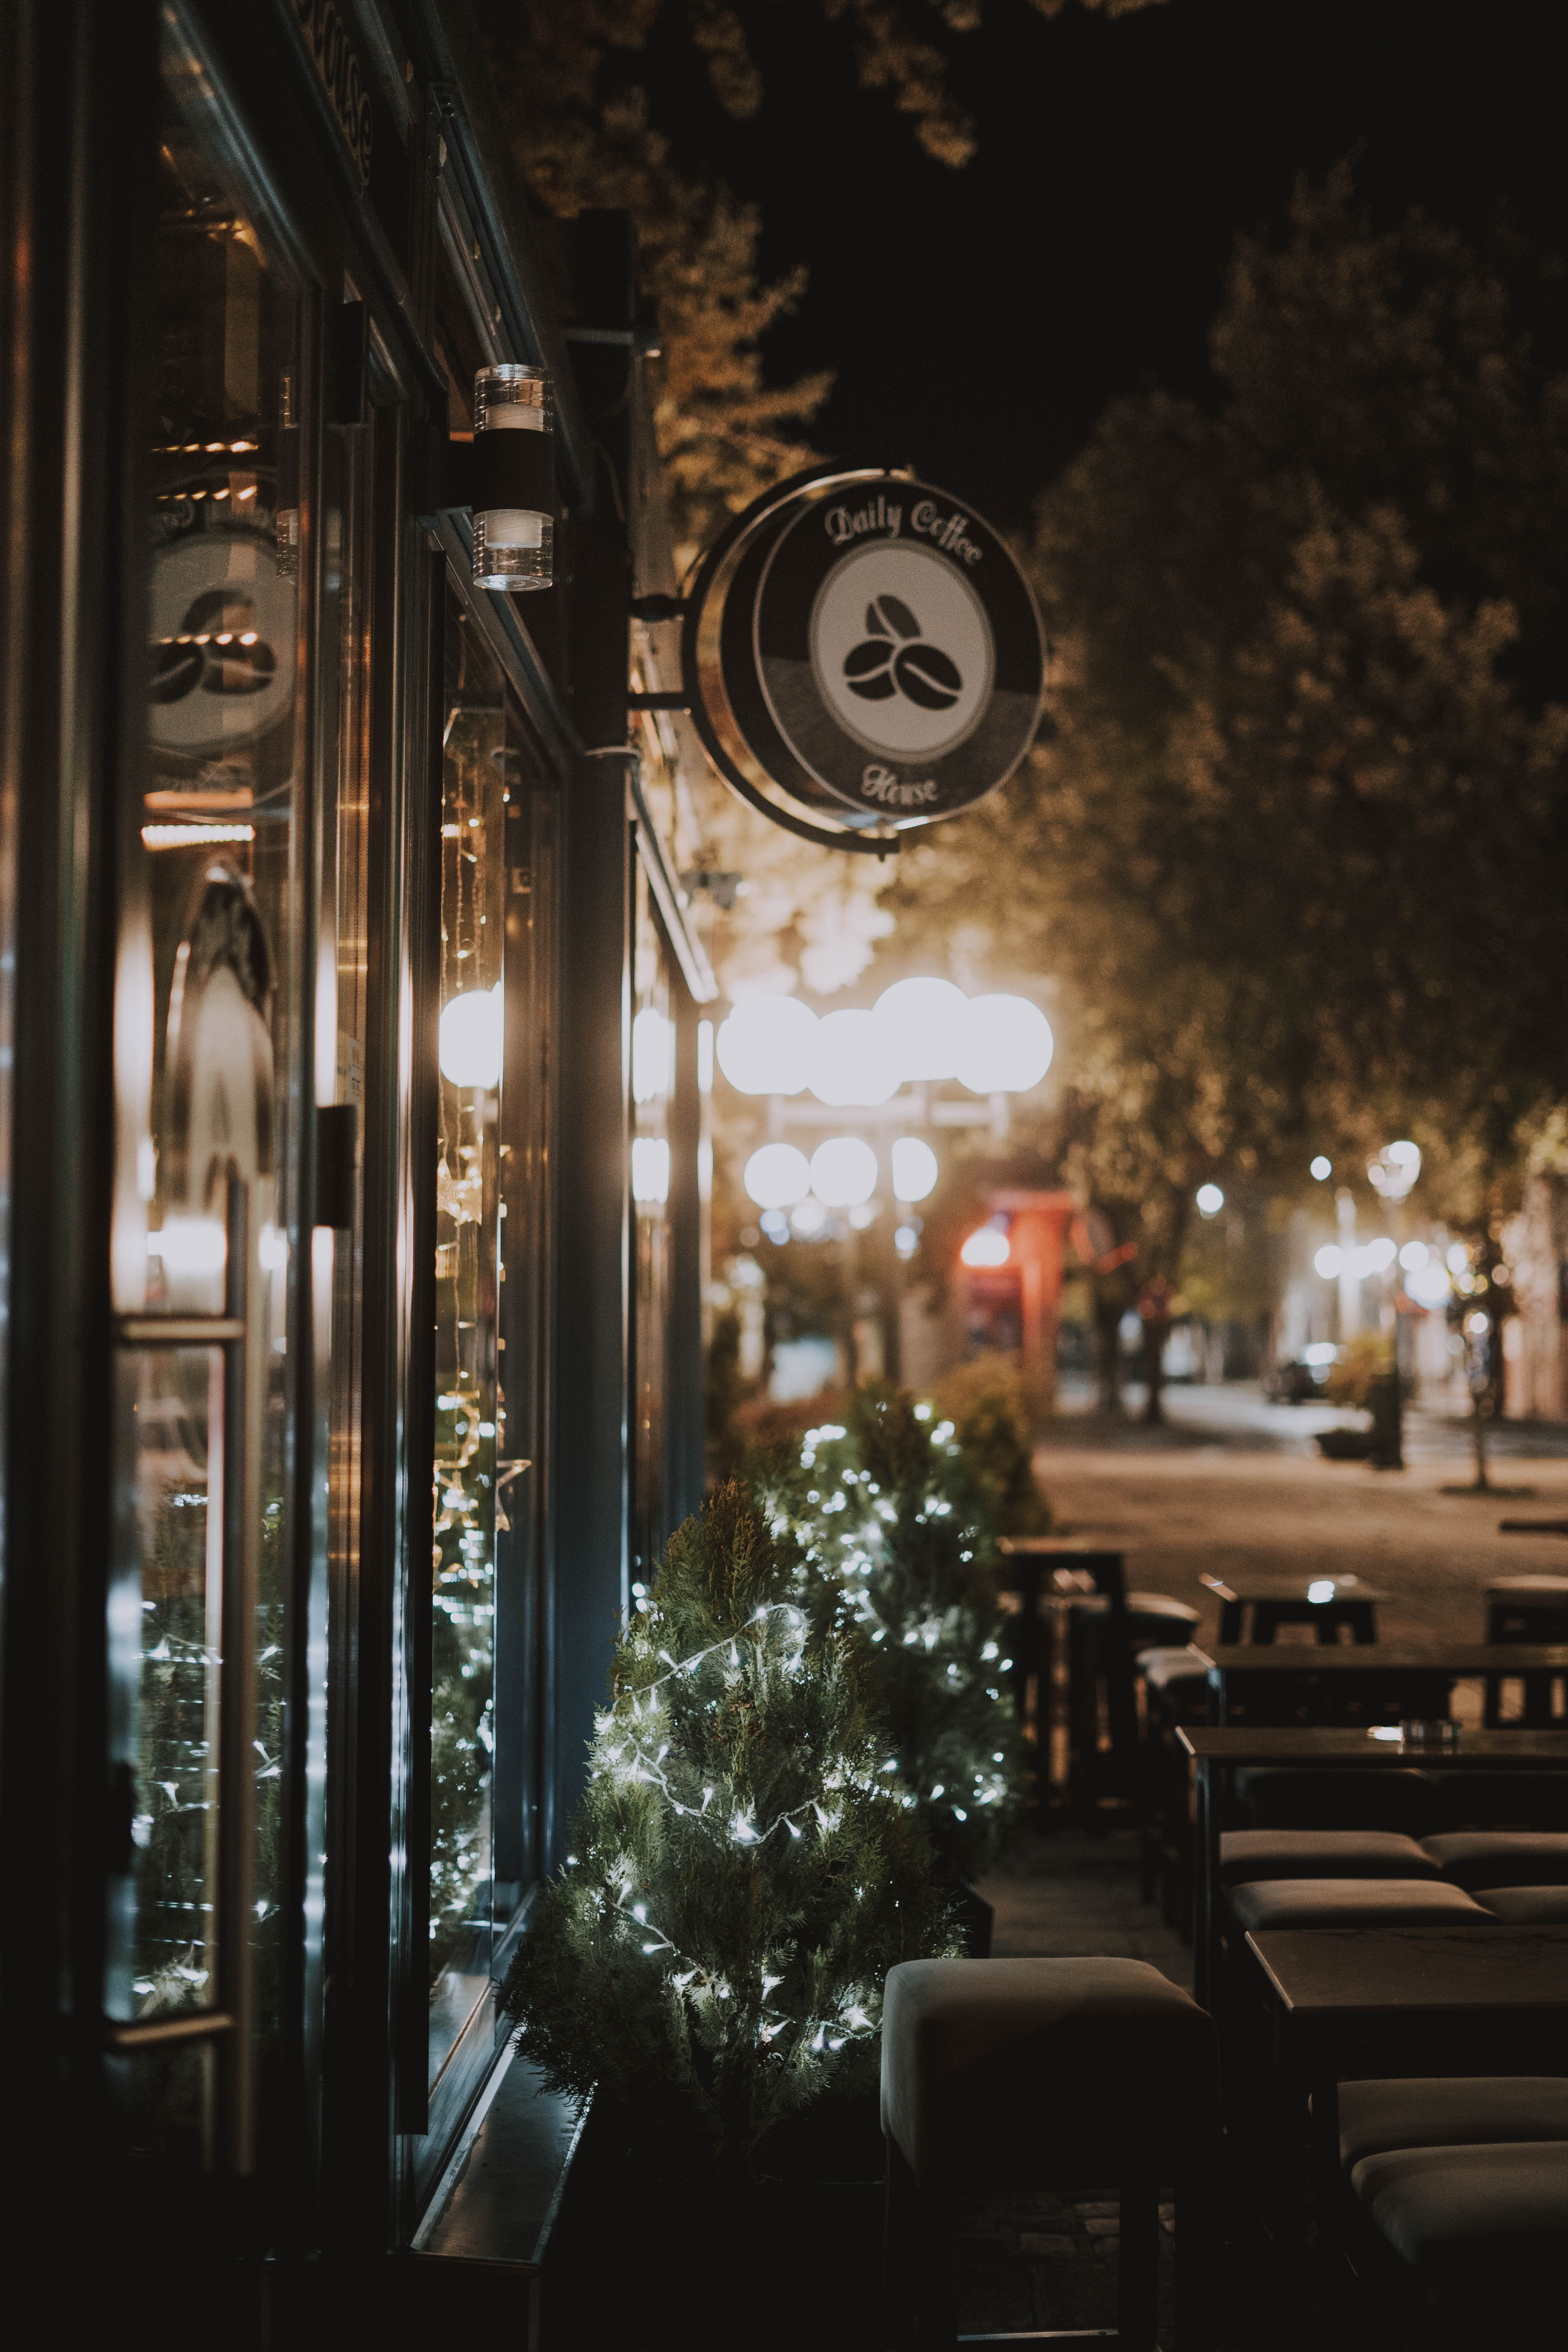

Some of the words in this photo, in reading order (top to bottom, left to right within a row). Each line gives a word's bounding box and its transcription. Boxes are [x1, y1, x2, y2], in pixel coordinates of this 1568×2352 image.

[824, 495, 902, 546] Daily
[911, 500, 983, 565] Coffee
[861, 764, 938, 805] House
